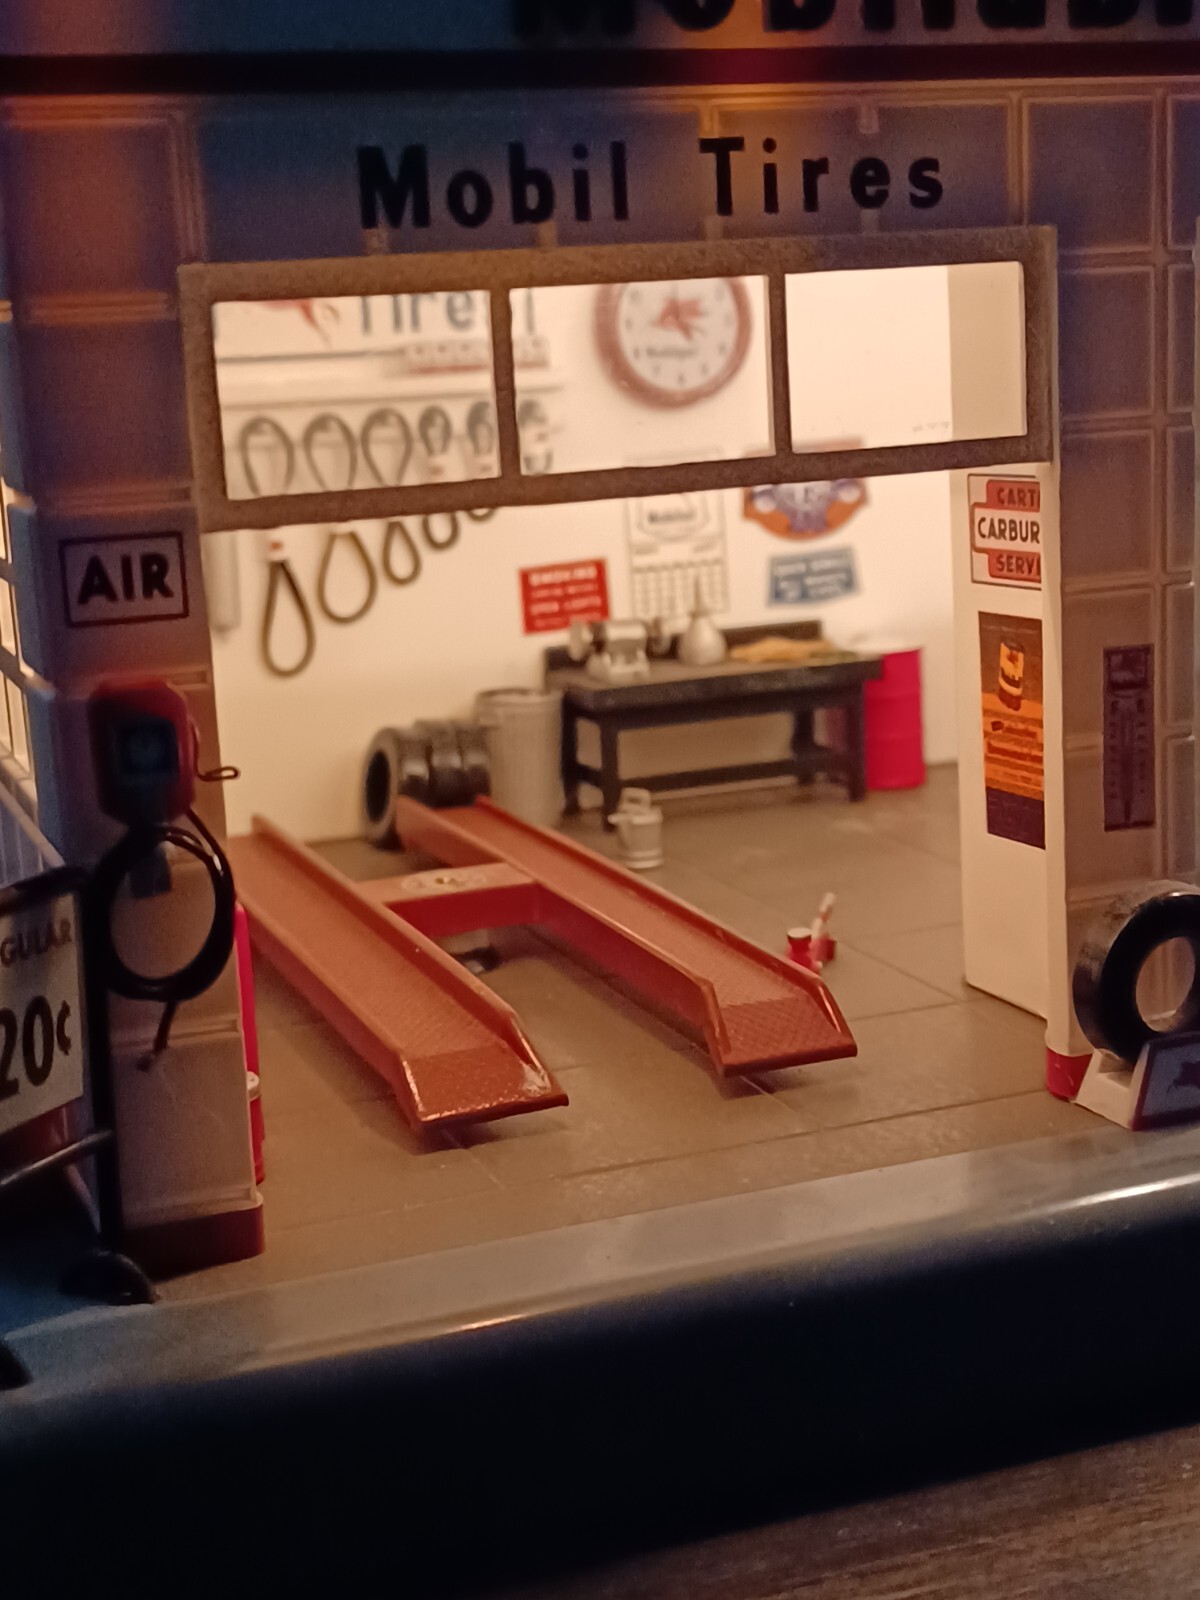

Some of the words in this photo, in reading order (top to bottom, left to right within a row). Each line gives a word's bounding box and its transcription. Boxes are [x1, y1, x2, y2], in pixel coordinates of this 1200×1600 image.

[357, 140, 630, 230] Mobil
[698, 136, 944, 216] Tires
[977, 516, 1041, 544] CARBUR
[78, 552, 175, 605] AIR
